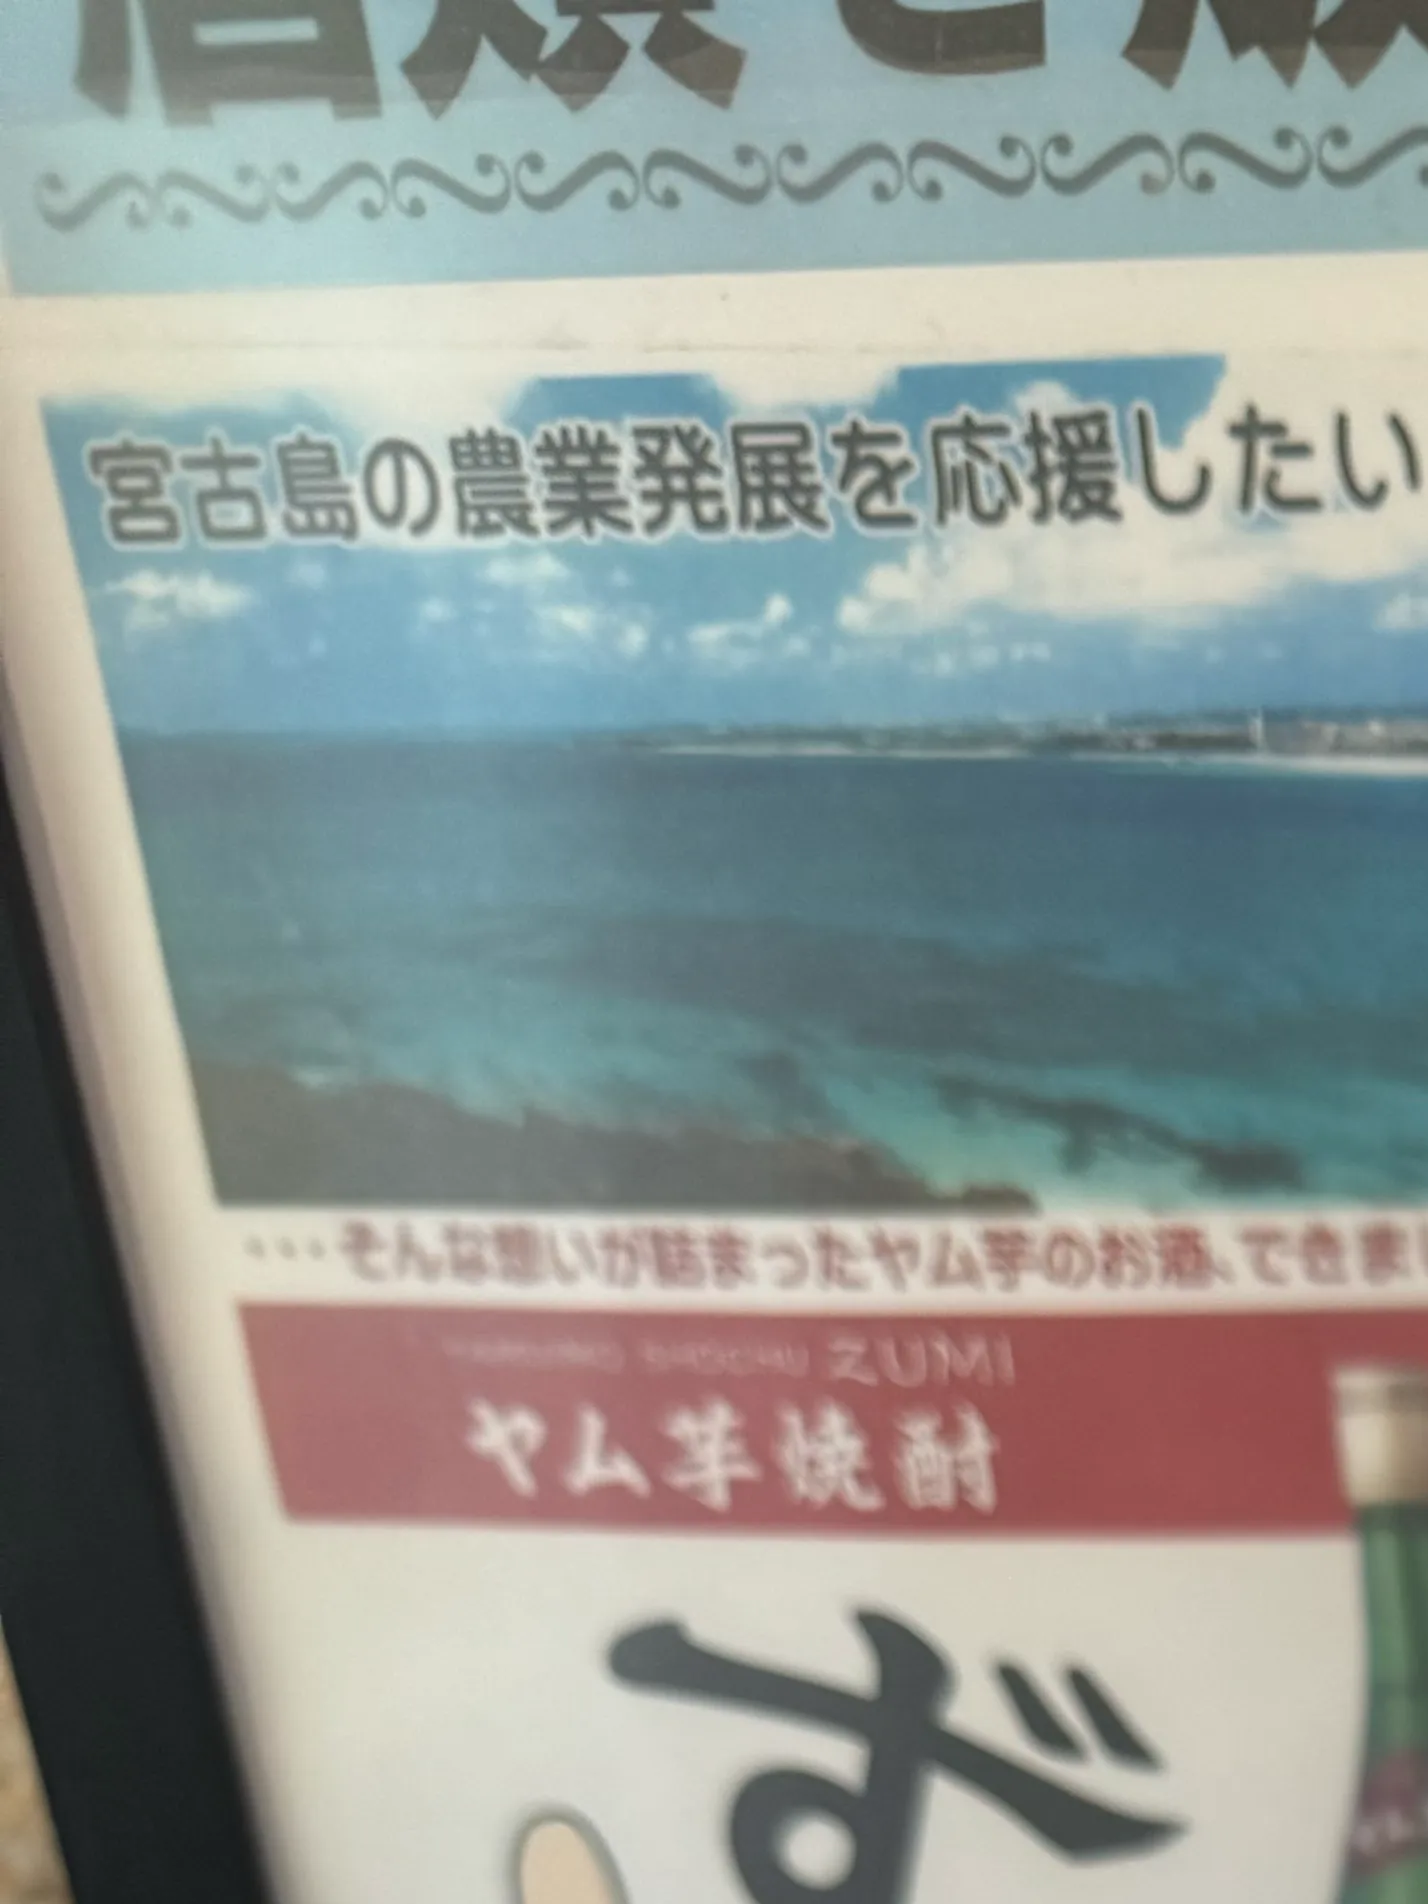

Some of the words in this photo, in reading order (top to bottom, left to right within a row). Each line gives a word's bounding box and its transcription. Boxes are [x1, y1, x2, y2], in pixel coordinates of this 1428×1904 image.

[826, 1330, 1016, 1388] ZUMI
[462, 1394, 1004, 1514] ヤム芋焼酎
